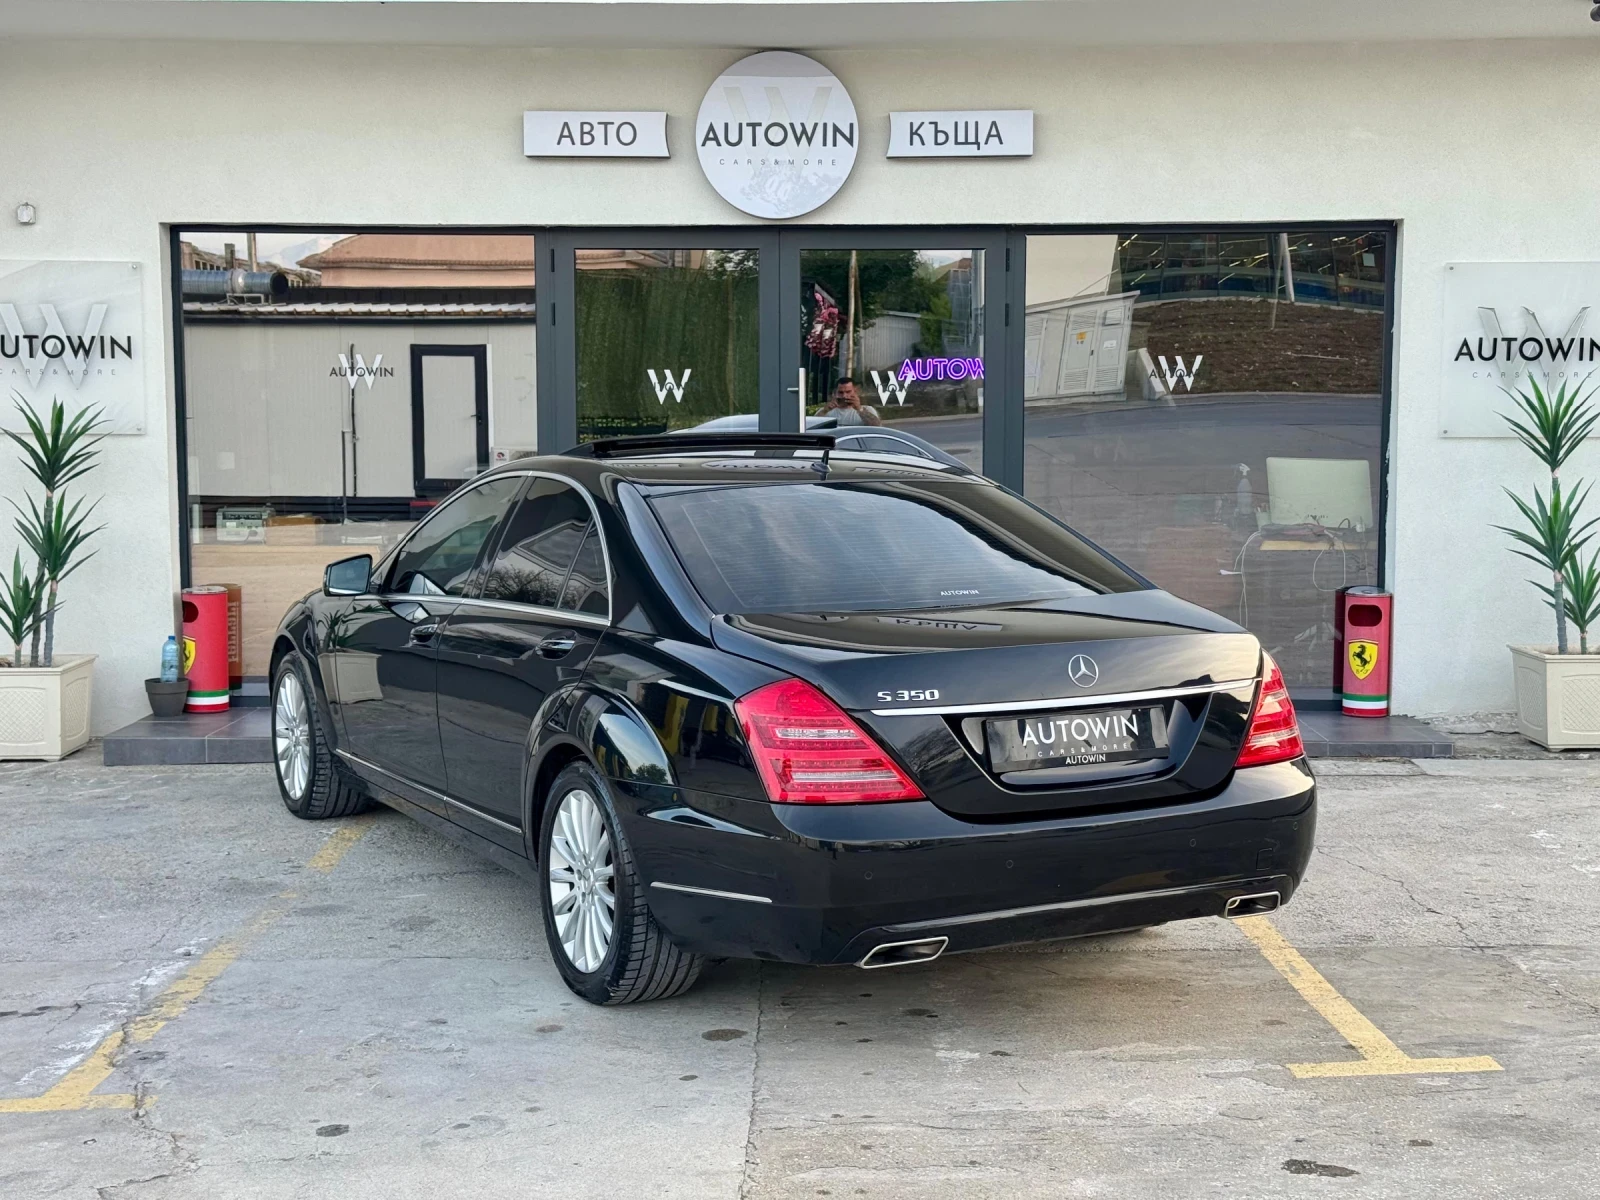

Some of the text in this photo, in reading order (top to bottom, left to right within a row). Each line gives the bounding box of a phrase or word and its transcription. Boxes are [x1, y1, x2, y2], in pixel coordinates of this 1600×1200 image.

[556, 120, 638, 147] АВТО
[701, 121, 854, 148] AUTOWIN
[908, 119, 1004, 151] КЪЩА
[329, 366, 394, 377] AUTOWIN
[1472, 371, 1593, 379] CARSMORE
[646, 368, 692, 405] W
[870, 370, 915, 407] W
[877, 689, 940, 702] S 350
[1023, 714, 1139, 746] AUTOWIN
[1037, 742, 1129, 758] CARS&MORE
[1065, 753, 1106, 765] AUTOWIN
